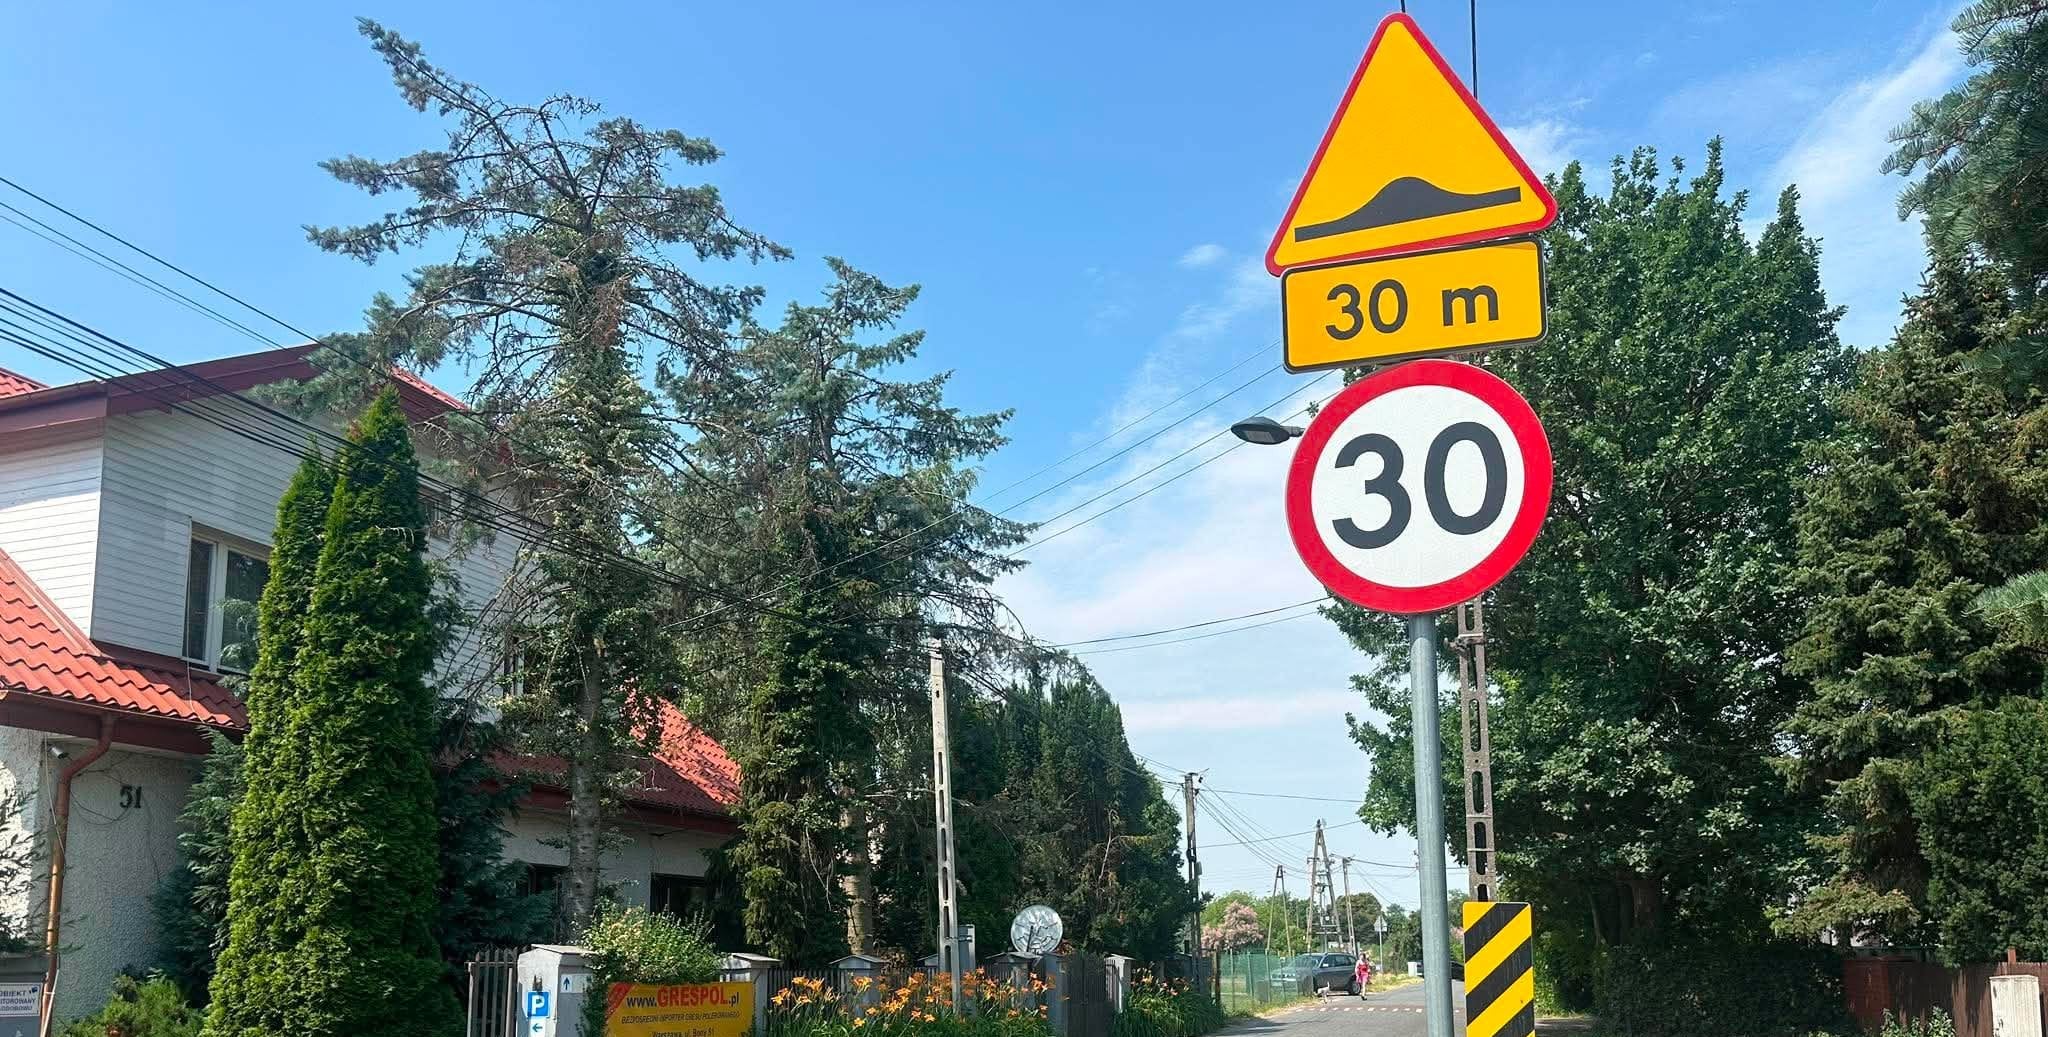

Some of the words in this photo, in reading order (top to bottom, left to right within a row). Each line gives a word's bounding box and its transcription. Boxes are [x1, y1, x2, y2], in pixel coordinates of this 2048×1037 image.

[1325, 279, 1408, 340] 30
[1442, 284, 1499, 326] m
[1332, 421, 1508, 550] 30
[531, 995, 545, 1015] P
[626, 986, 739, 1008] www.GRESPOL.pl
